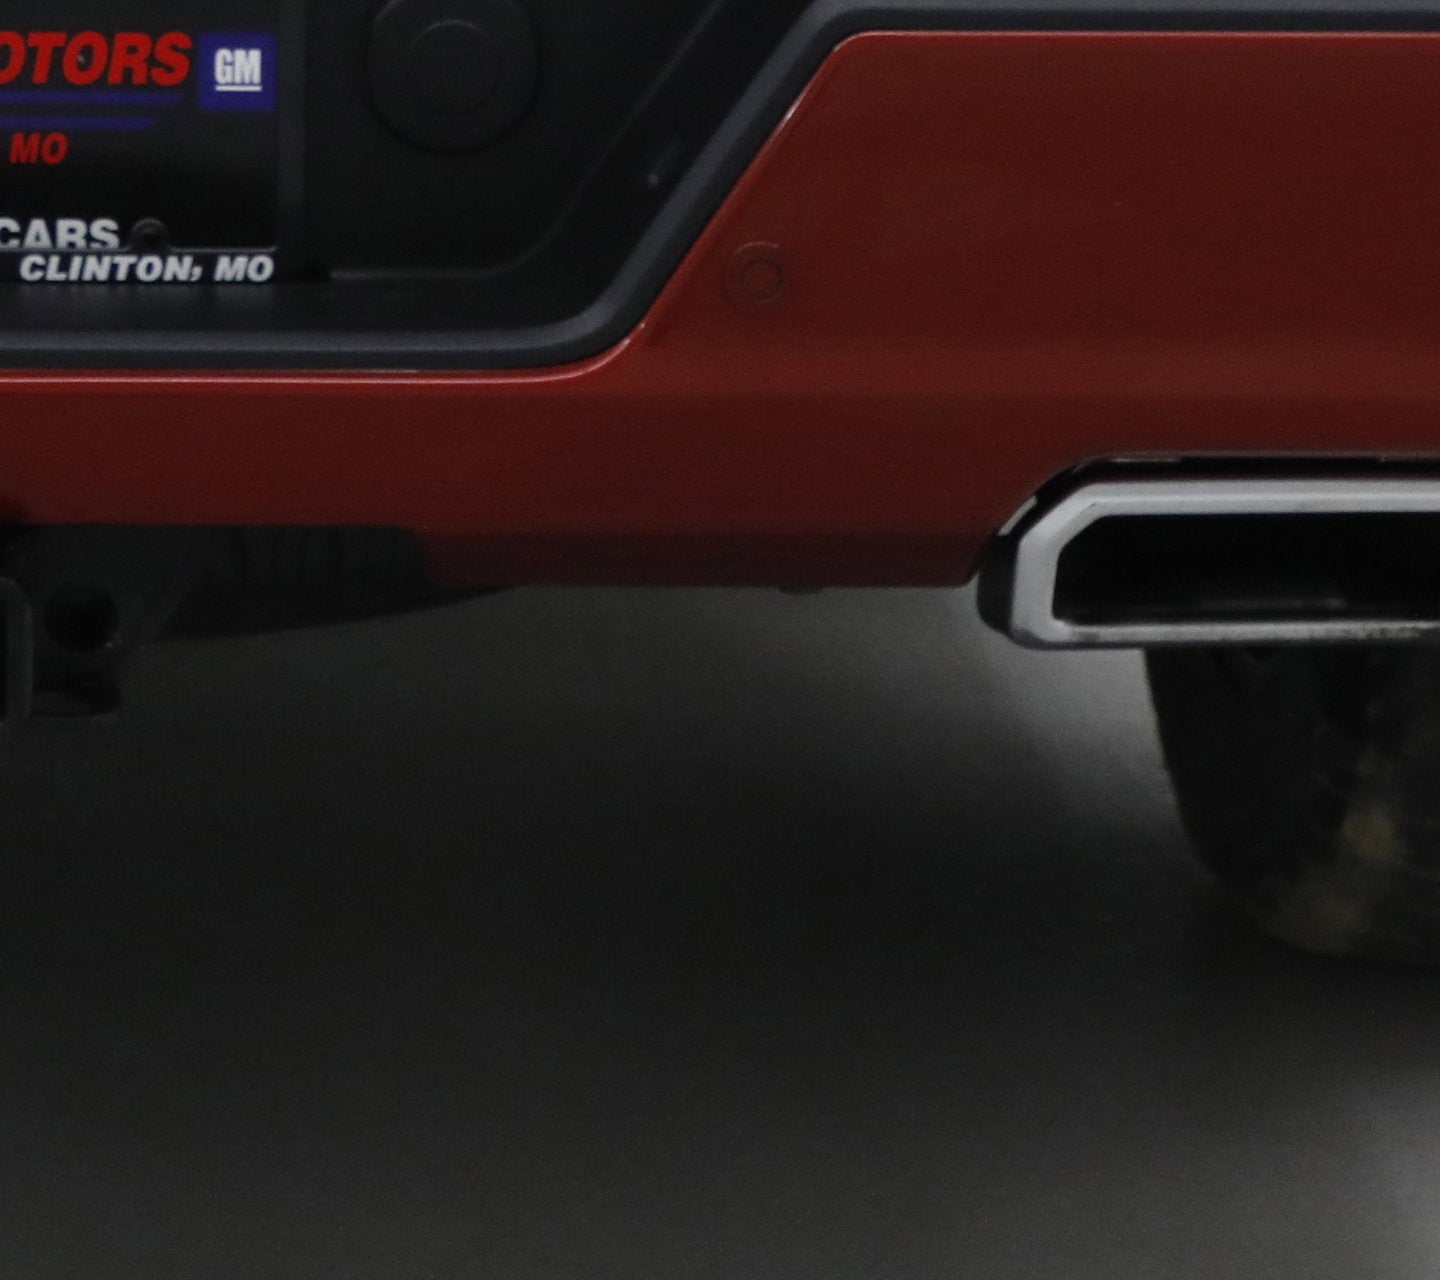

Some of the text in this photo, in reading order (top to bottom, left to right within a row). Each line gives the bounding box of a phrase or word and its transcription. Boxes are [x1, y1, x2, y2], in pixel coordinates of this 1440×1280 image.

[213, 48, 263, 85] GM
[9, 132, 68, 165] MO
[19, 253, 275, 283] CLINTON, MO
